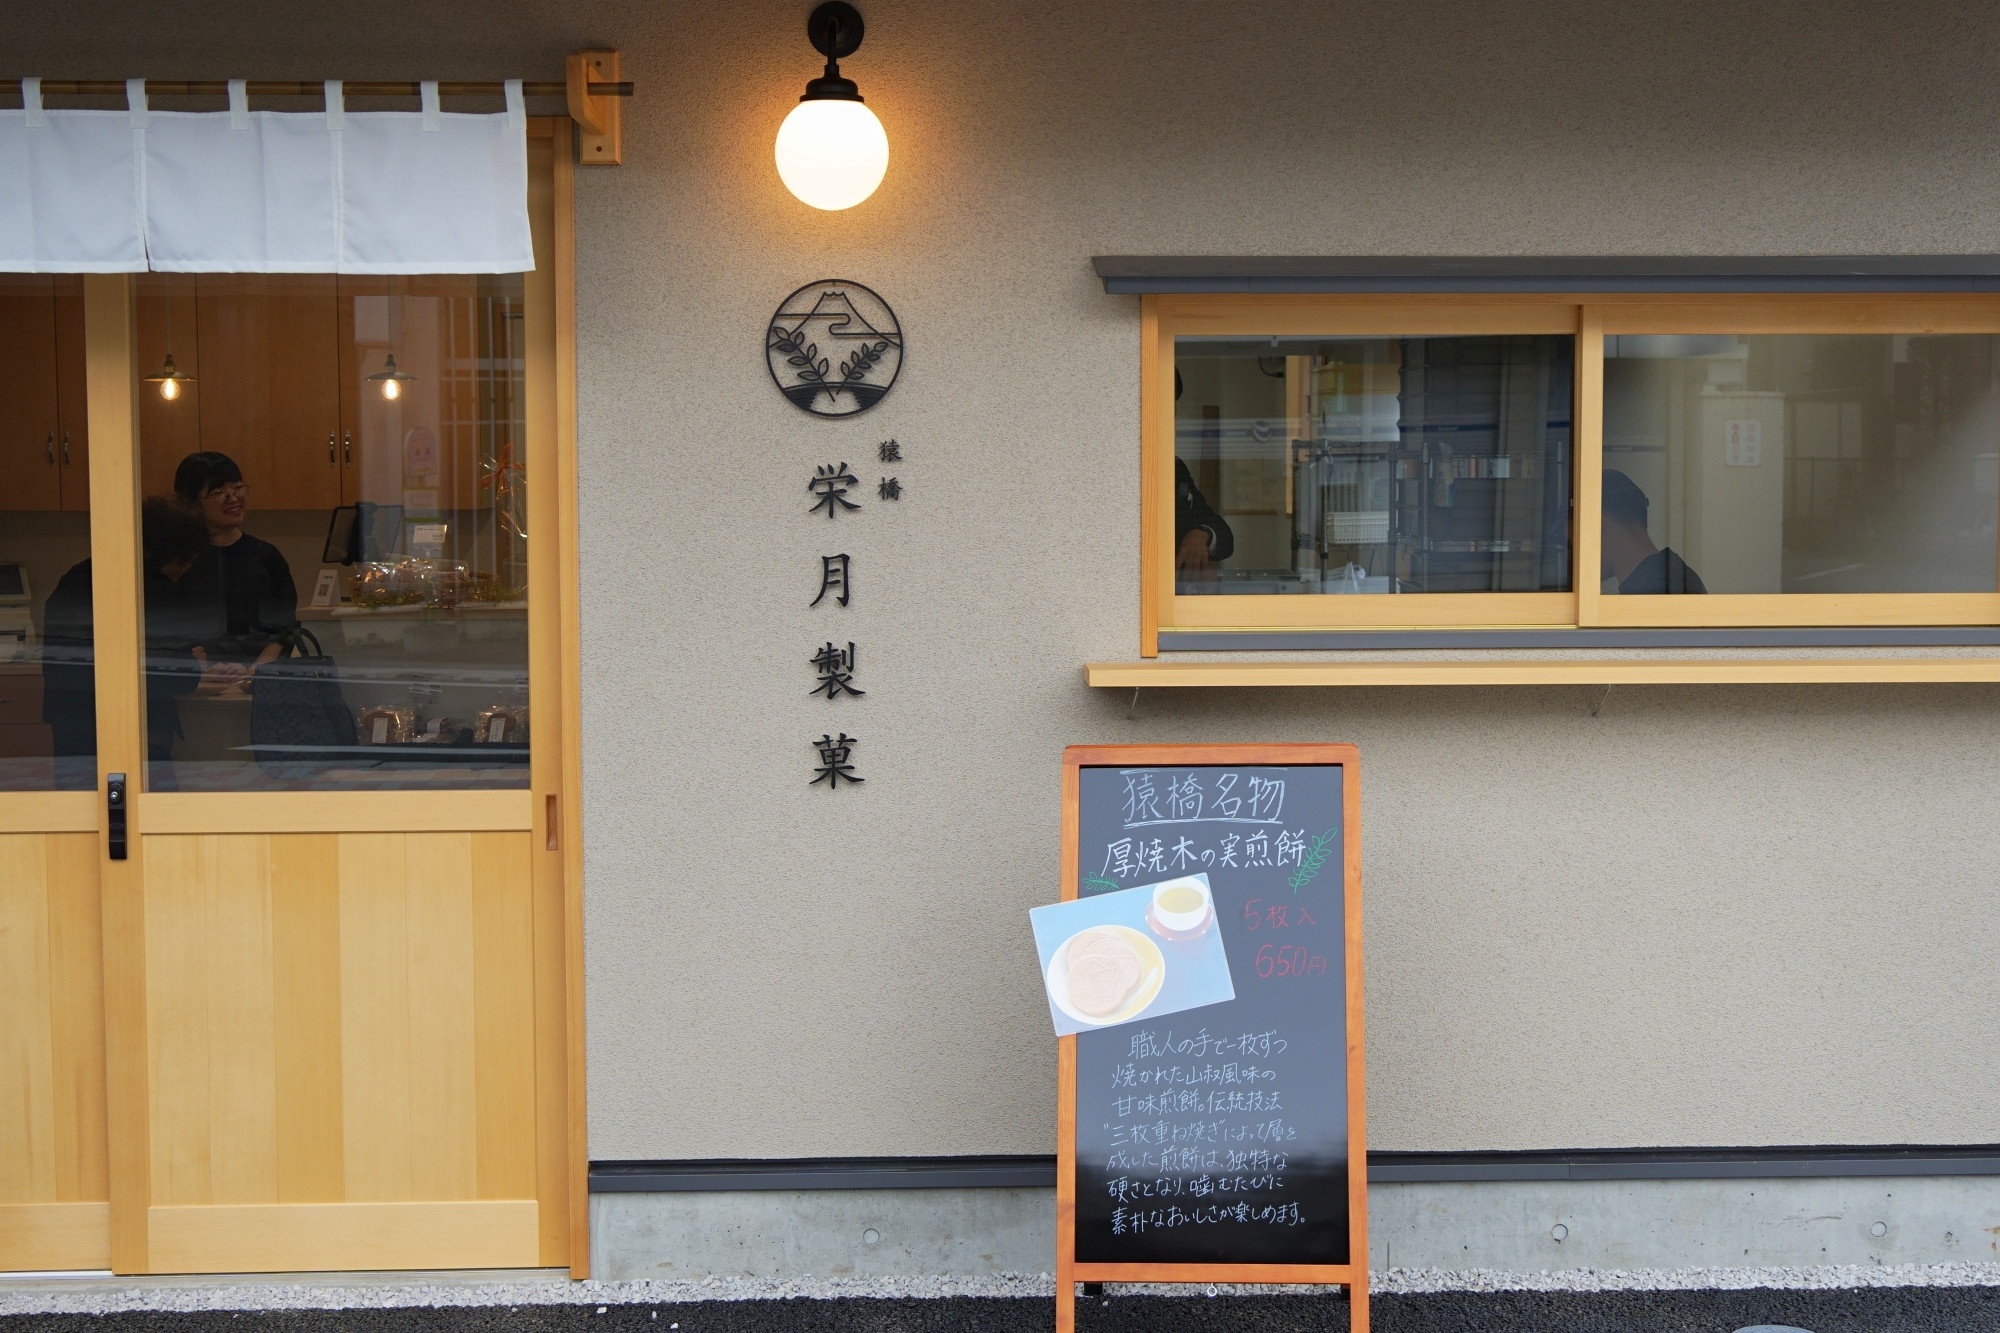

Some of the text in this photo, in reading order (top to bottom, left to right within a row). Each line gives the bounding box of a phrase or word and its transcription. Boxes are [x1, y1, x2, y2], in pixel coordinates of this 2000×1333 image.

[878, 439, 903, 501] 猿橋
[809, 461, 866, 790] 栄月製菓
[1121, 772, 1286, 822] 猿橋名物
[1101, 829, 1307, 878] 厚焼木の実煎餅
[1244, 898, 1317, 932] 5枚入
[1256, 944, 1327, 978] 650円
[1128, 1027, 1288, 1060] 職人の手で一枚ずつ
[1106, 1145, 1289, 1173] 成した煎餅は、独特な
[1106, 1174, 1284, 1204] 硬さとなり、噛むたびに
[1110, 1200, 1306, 1235] 素朴なおいしさが楽しめます。
